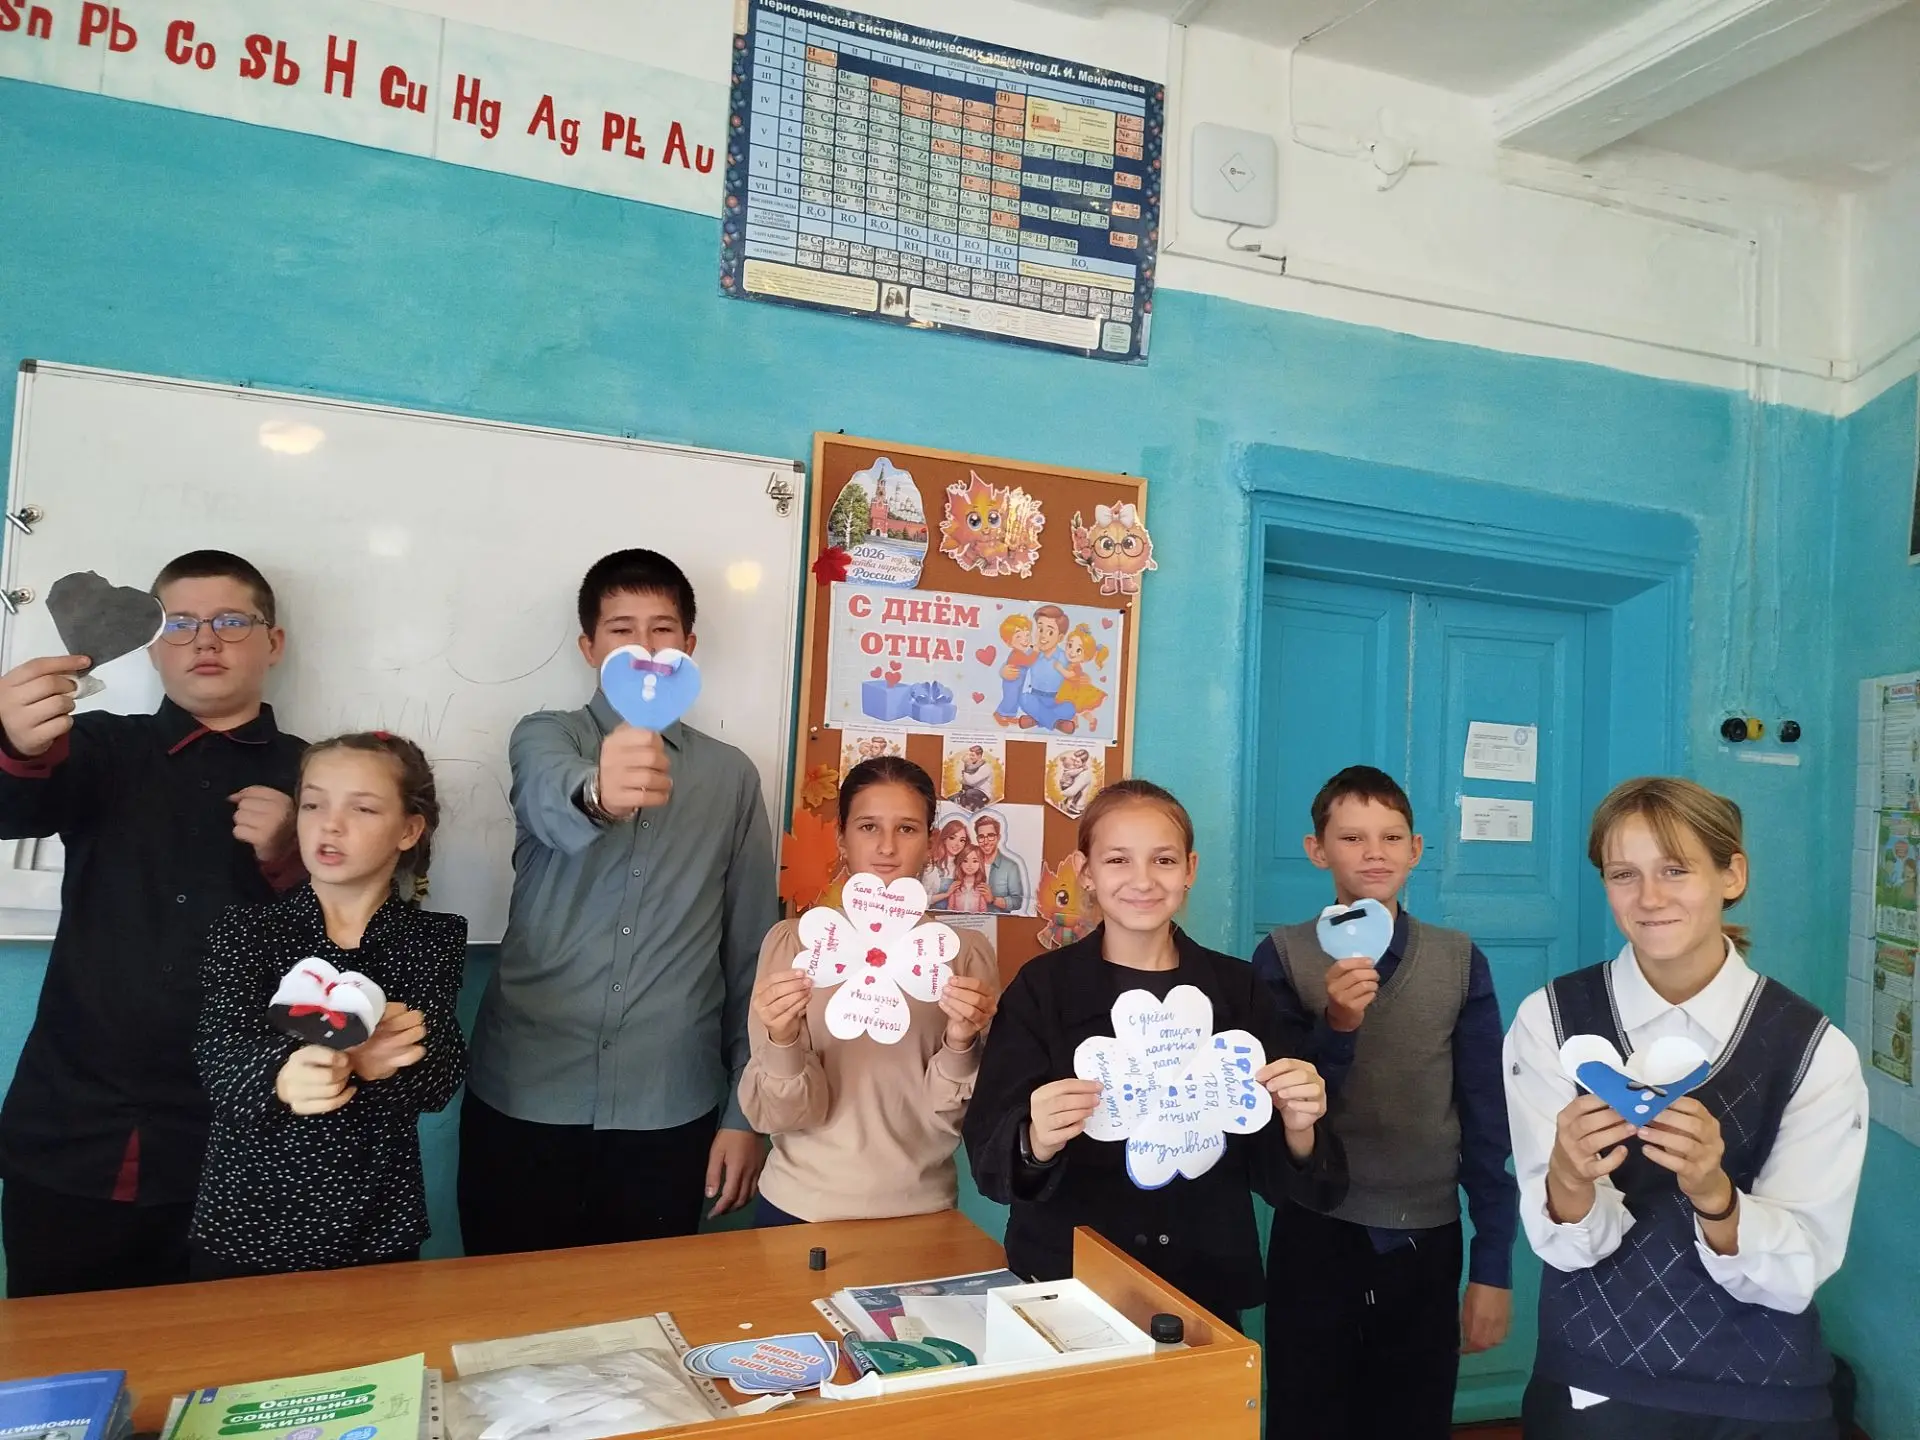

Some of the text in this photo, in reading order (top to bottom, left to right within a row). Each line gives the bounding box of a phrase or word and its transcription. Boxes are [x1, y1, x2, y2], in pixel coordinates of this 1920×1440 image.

[808, 47, 815, 56] H
[859, 23, 909, 43] система
[911, 34, 984, 60] химических
[986, 52, 1047, 73] элементов
[1049, 64, 1062, 78] Д.
[1063, 66, 1076, 80] И.
[1078, 70, 1145, 94] Менделеева
[808, 64, 816, 72] Li
[840, 72, 851, 80] Be
[0, 0, 714, 174] Sn Pb Co Sb H Cu Hg Ag Pt Au
[807, 79, 819, 88] Na
[840, 86, 855, 98] Mg
[806, 94, 812, 102] K
[998, 93, 1010, 102] (H)
[840, 102, 851, 111] Ca
[804, 126, 817, 134] Rb
[854, 121, 866, 130] Zn
[838, 132, 848, 140] Sr
[902, 132, 914, 140] Ge
[953, 128, 959, 136] V
[932, 140, 944, 148] As
[1006, 139, 1020, 147] Mn
[820, 145, 832, 156] Ag
[852, 151, 864, 160] Cd
[869, 155, 879, 163] In
[946, 156, 958, 164] Nb
[803, 157, 814, 165] Cs
[837, 164, 848, 172] Ba
[976, 163, 990, 172] Mo
[931, 169, 943, 178] Sb
[962, 176, 973, 184] Te
[850, 182, 864, 193] Hg
[900, 192, 911, 201] Pb
[841, 214, 857, 224] RO
[861, 246, 874, 254] Nd
[996, 262, 1010, 271] HR
[852, 568, 897, 581] России
[848, 594, 980, 628] С ДНЁМ
[860, 632, 965, 663] ОТЦА!
[730, 1358, 770, 1371] ПАПА
[260, 1392, 346, 1409] Основы
[230, 1396, 369, 1423] социальной
[258, 1413, 336, 1430] жизни
